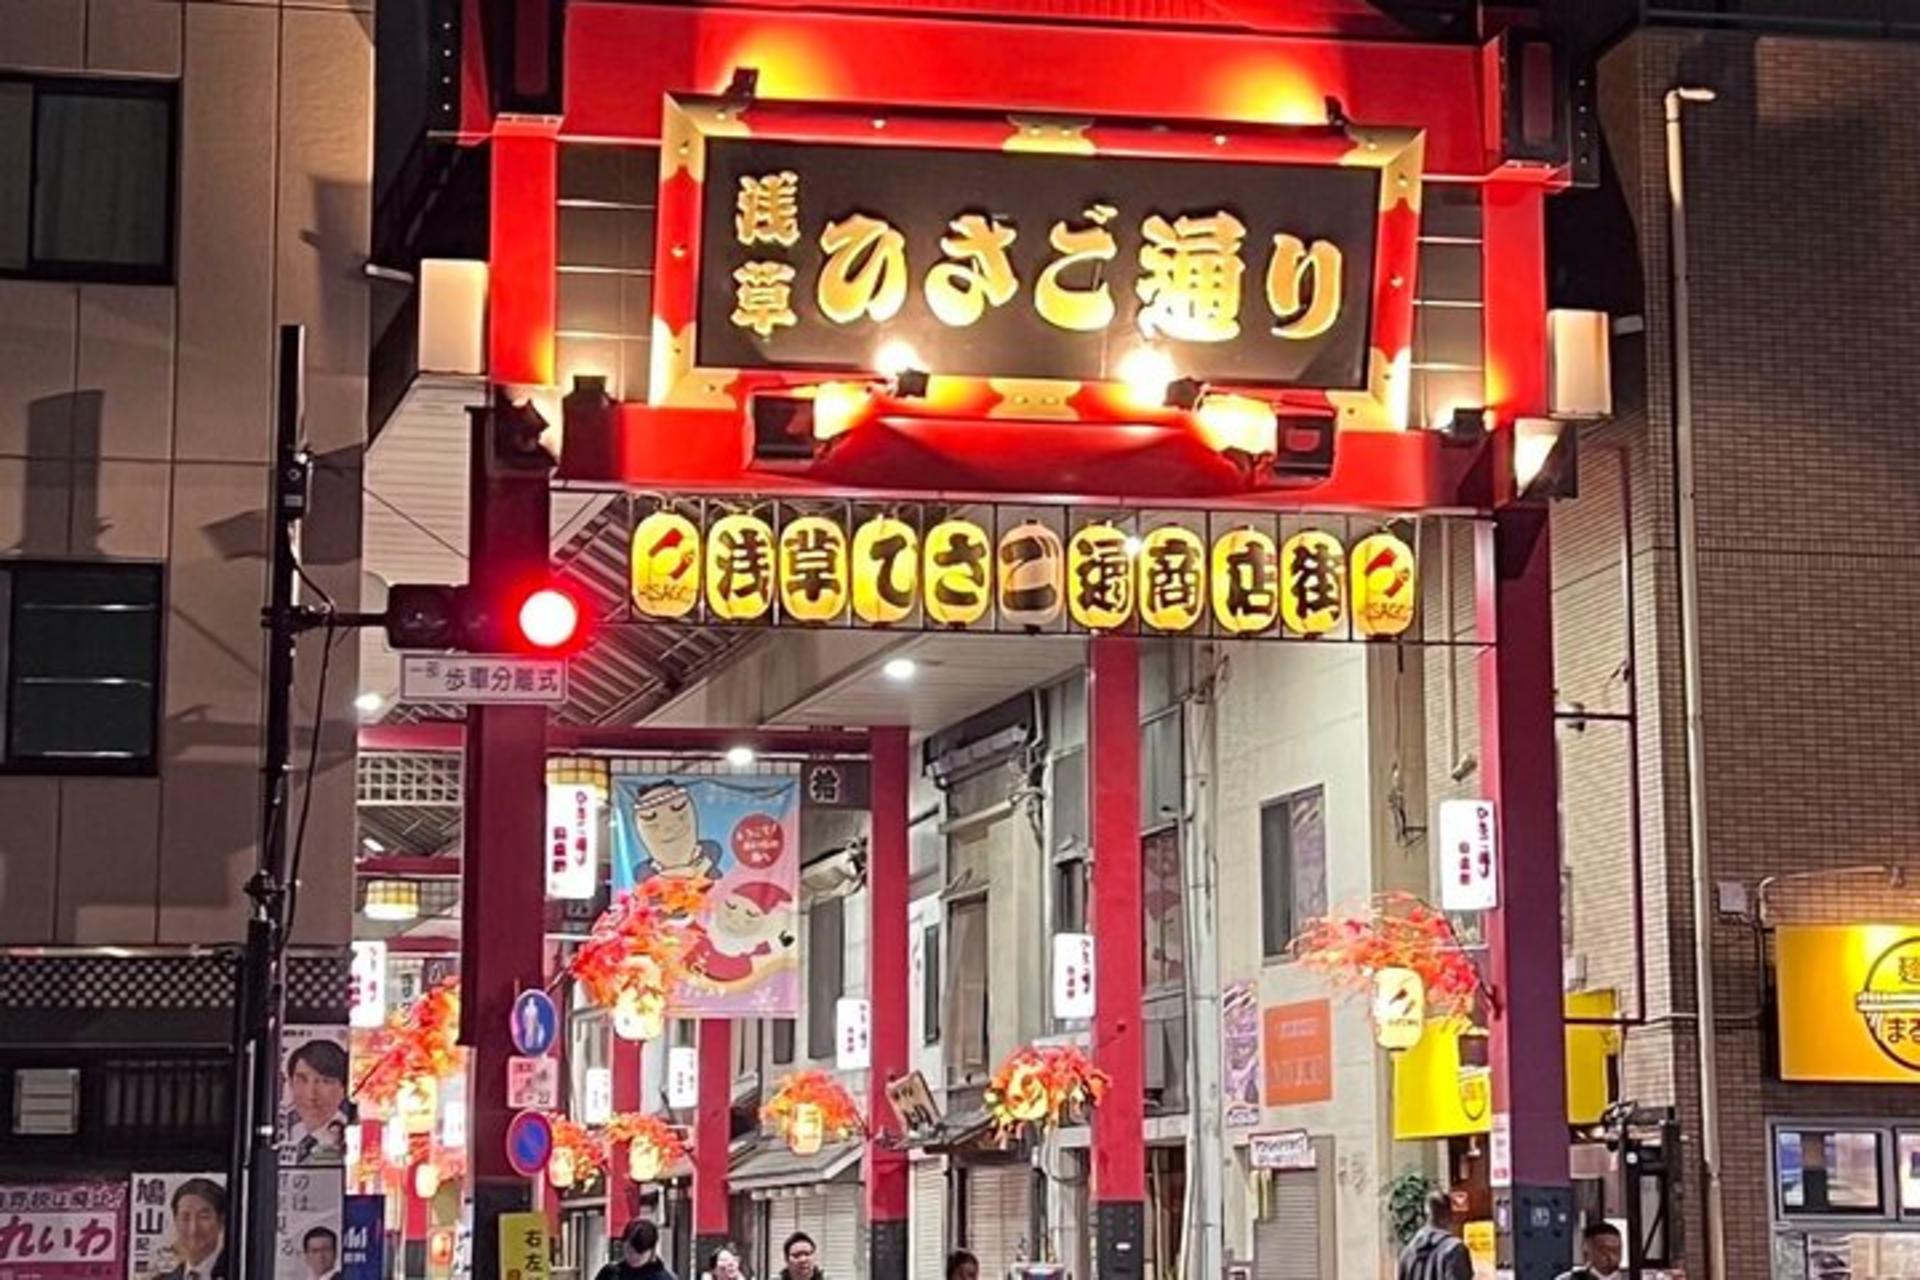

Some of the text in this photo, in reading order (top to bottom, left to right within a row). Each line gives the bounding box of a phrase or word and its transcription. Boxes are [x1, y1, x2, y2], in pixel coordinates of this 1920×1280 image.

[731, 171, 800, 340] 浅草
[817, 203, 1343, 342] ひさご通り
[445, 665, 557, 692] 歩車分離式
[0, 1214, 113, 1259] れいわ
[524, 1229, 542, 1280] 右左
